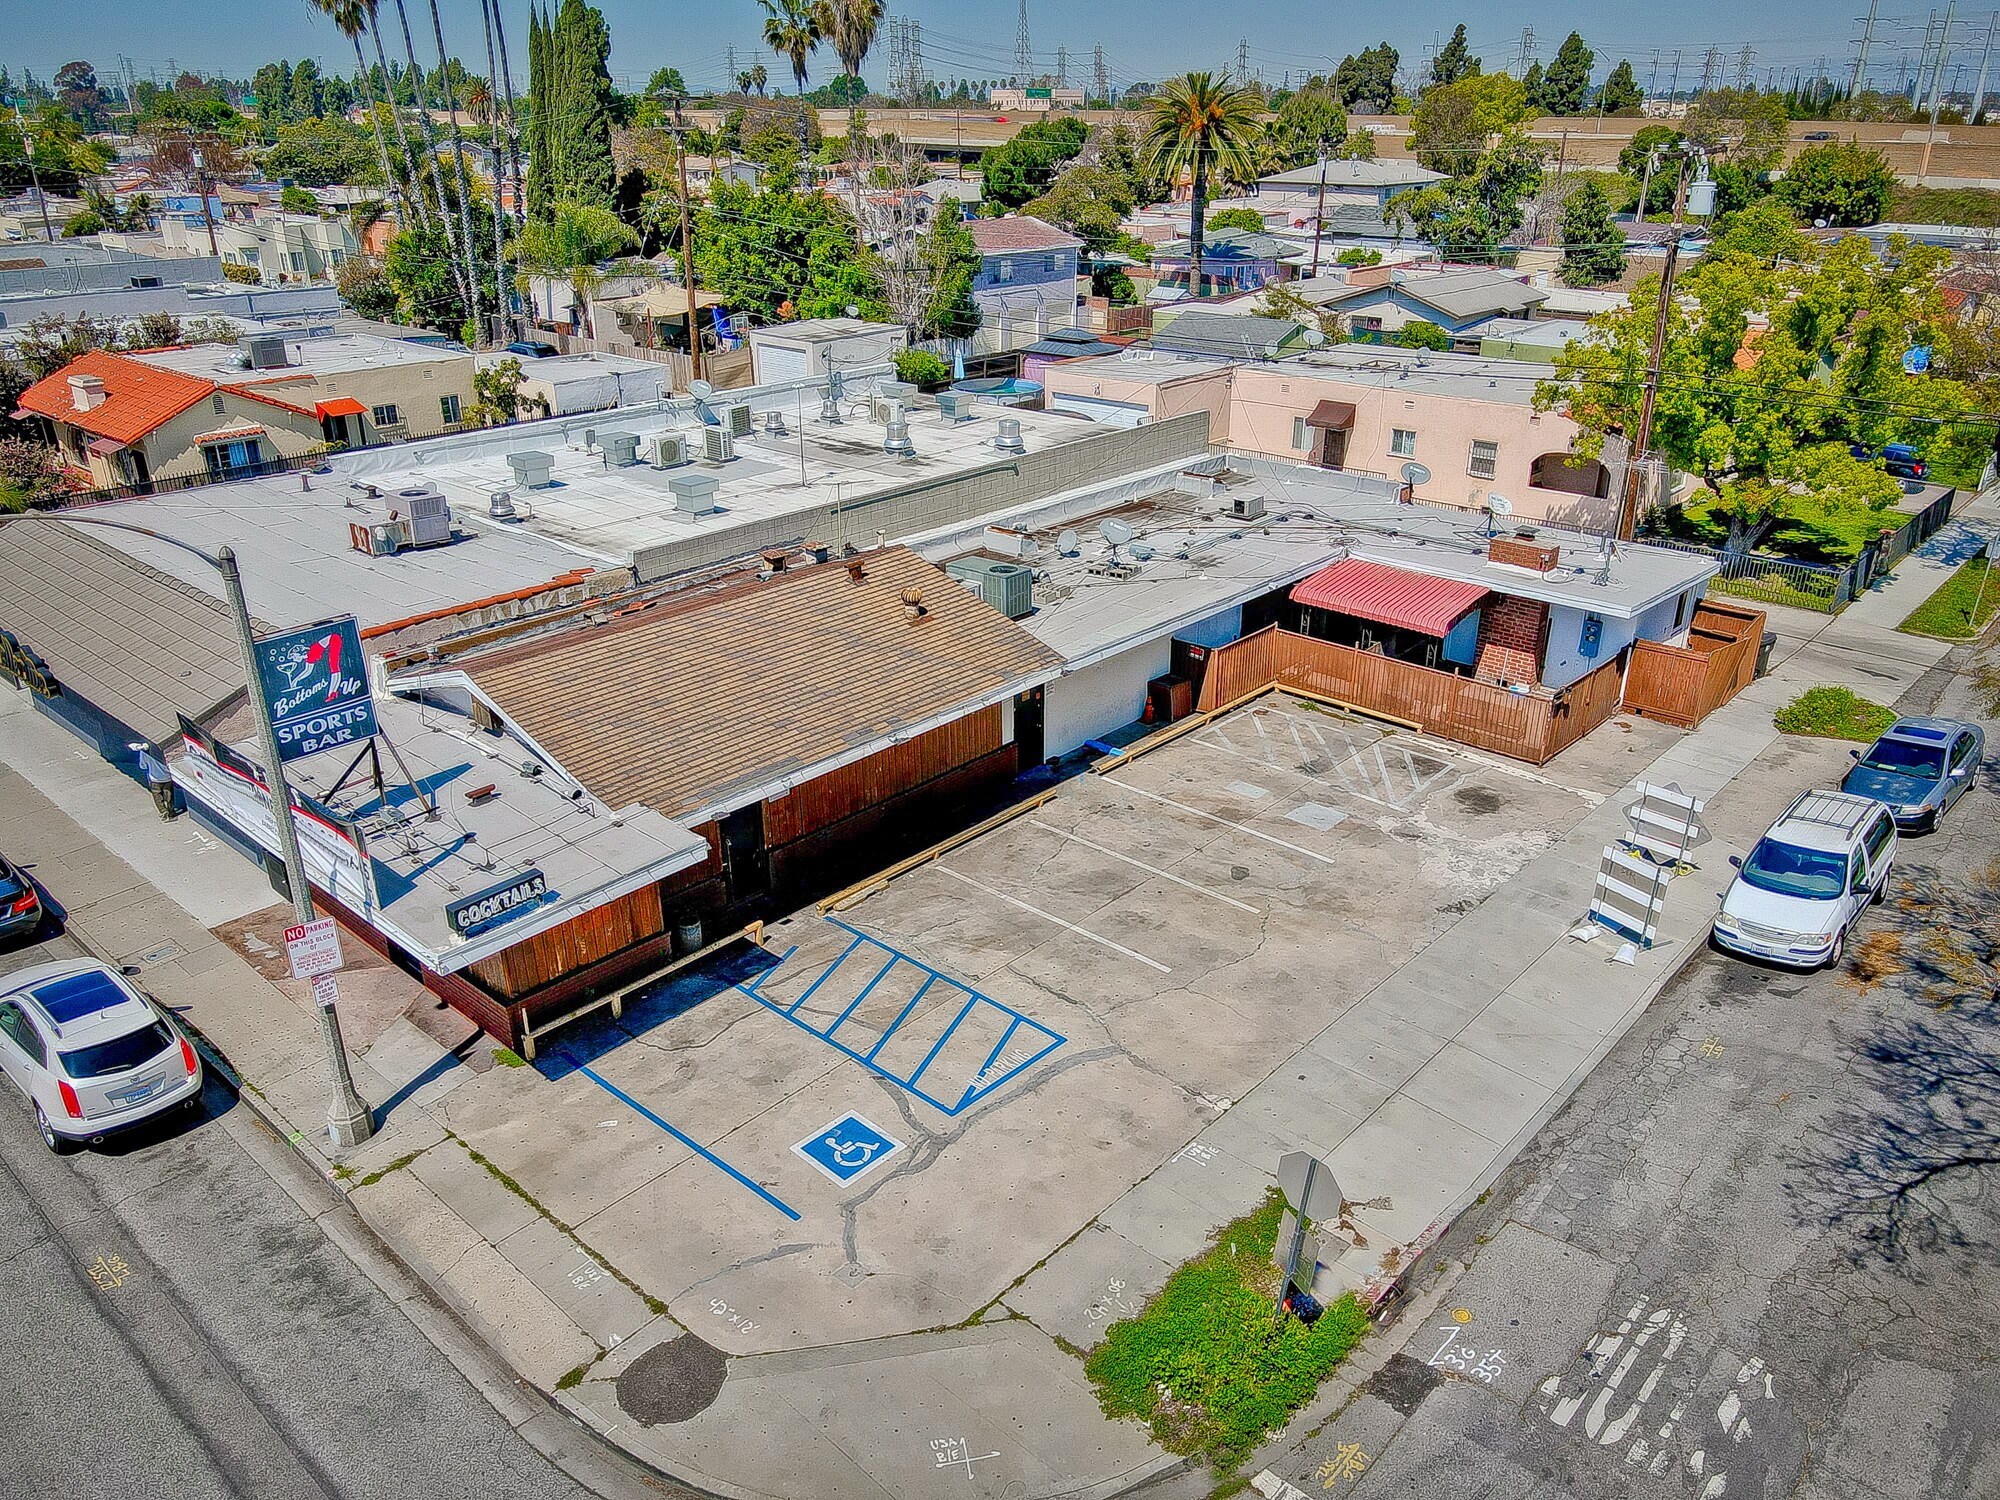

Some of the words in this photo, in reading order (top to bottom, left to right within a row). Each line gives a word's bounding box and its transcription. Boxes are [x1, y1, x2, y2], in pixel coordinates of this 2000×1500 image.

[274, 678, 329, 718] Bottoms
[340, 677, 362, 695] Up
[278, 705, 368, 744] SPORTS
[302, 728, 354, 753] BAR
[457, 877, 546, 927] COCKTAILS
[287, 927, 304, 941] NO
[305, 920, 334, 935] PARKING
[300, 939, 314, 947] THIS
[316, 932, 336, 942] BLOCK
[982, 1048, 1032, 1080] PARKING
[929, 1437, 958, 1450] USA
